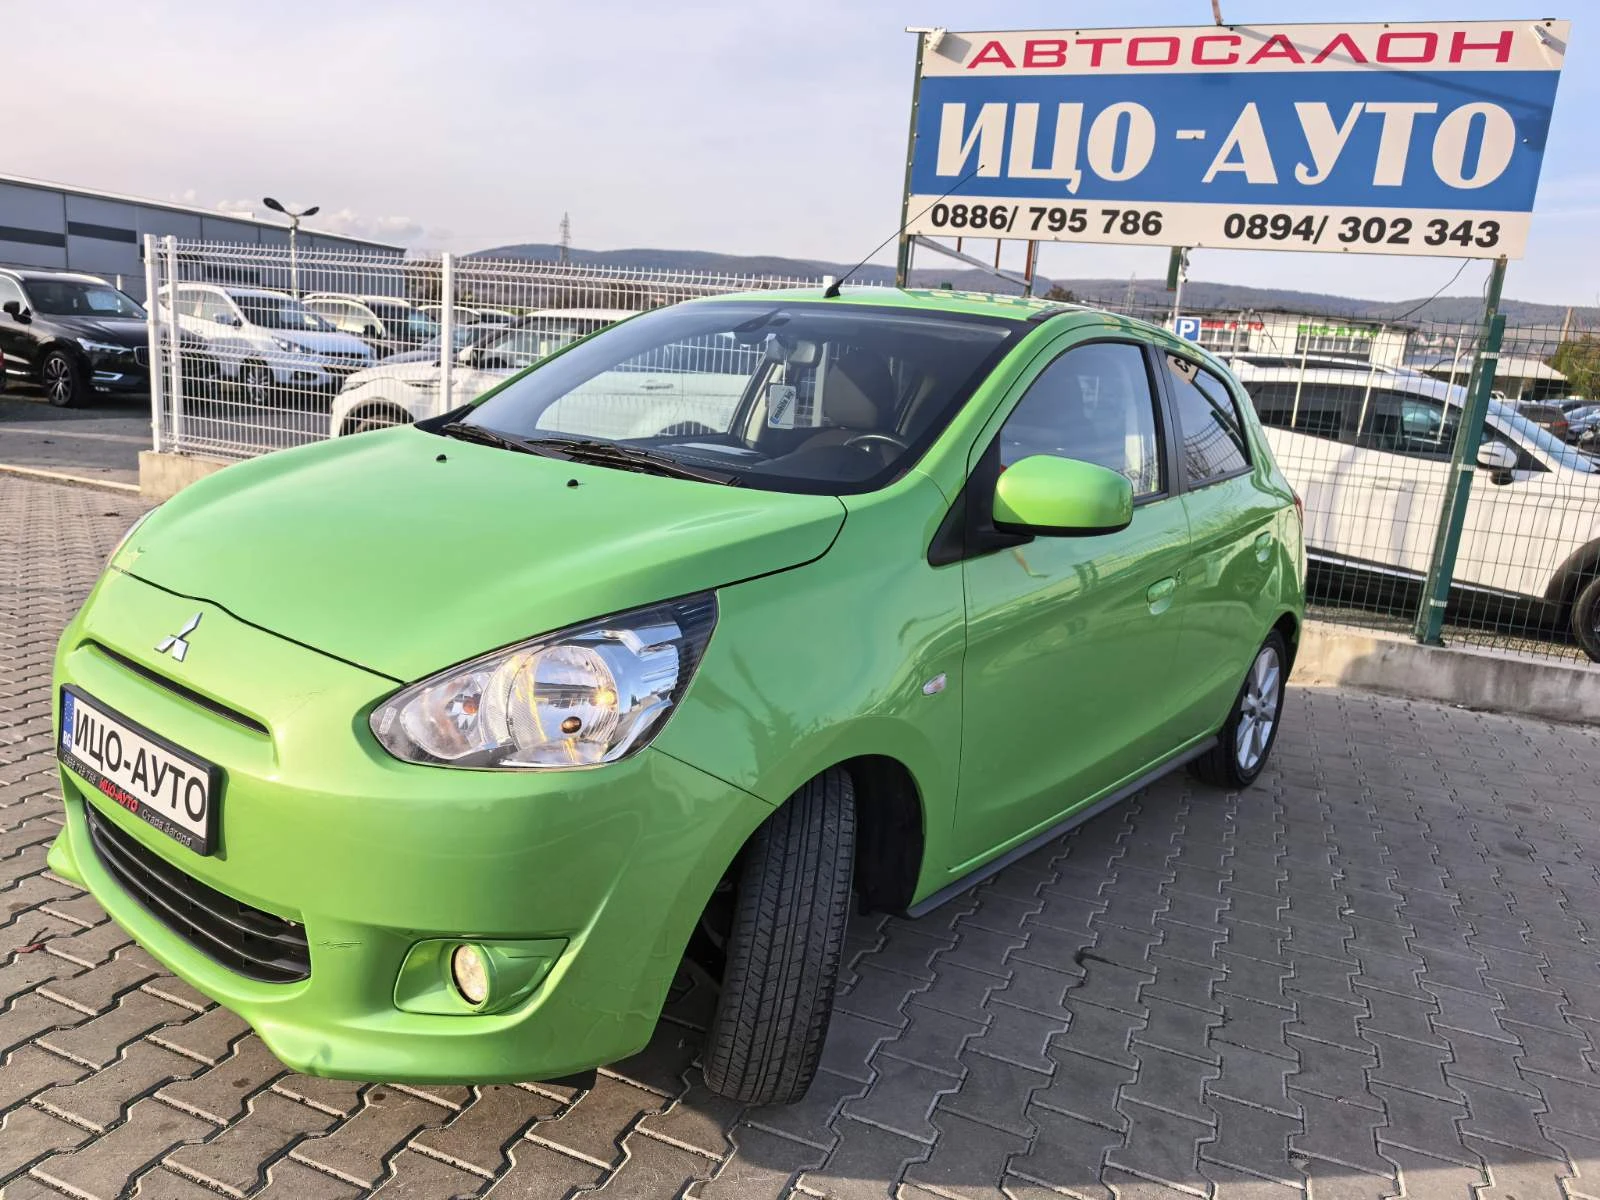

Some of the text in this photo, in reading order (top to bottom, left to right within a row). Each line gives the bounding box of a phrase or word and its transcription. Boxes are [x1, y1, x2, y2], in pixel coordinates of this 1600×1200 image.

[967, 32, 1512, 68] АВТОСАЛОН
[931, 203, 1163, 236] 0886/ 795 786
[1223, 213, 1501, 248] 0894/ 302 343
[63, 730, 72, 748] BG
[74, 708, 207, 823] ИЦО-АУТО
